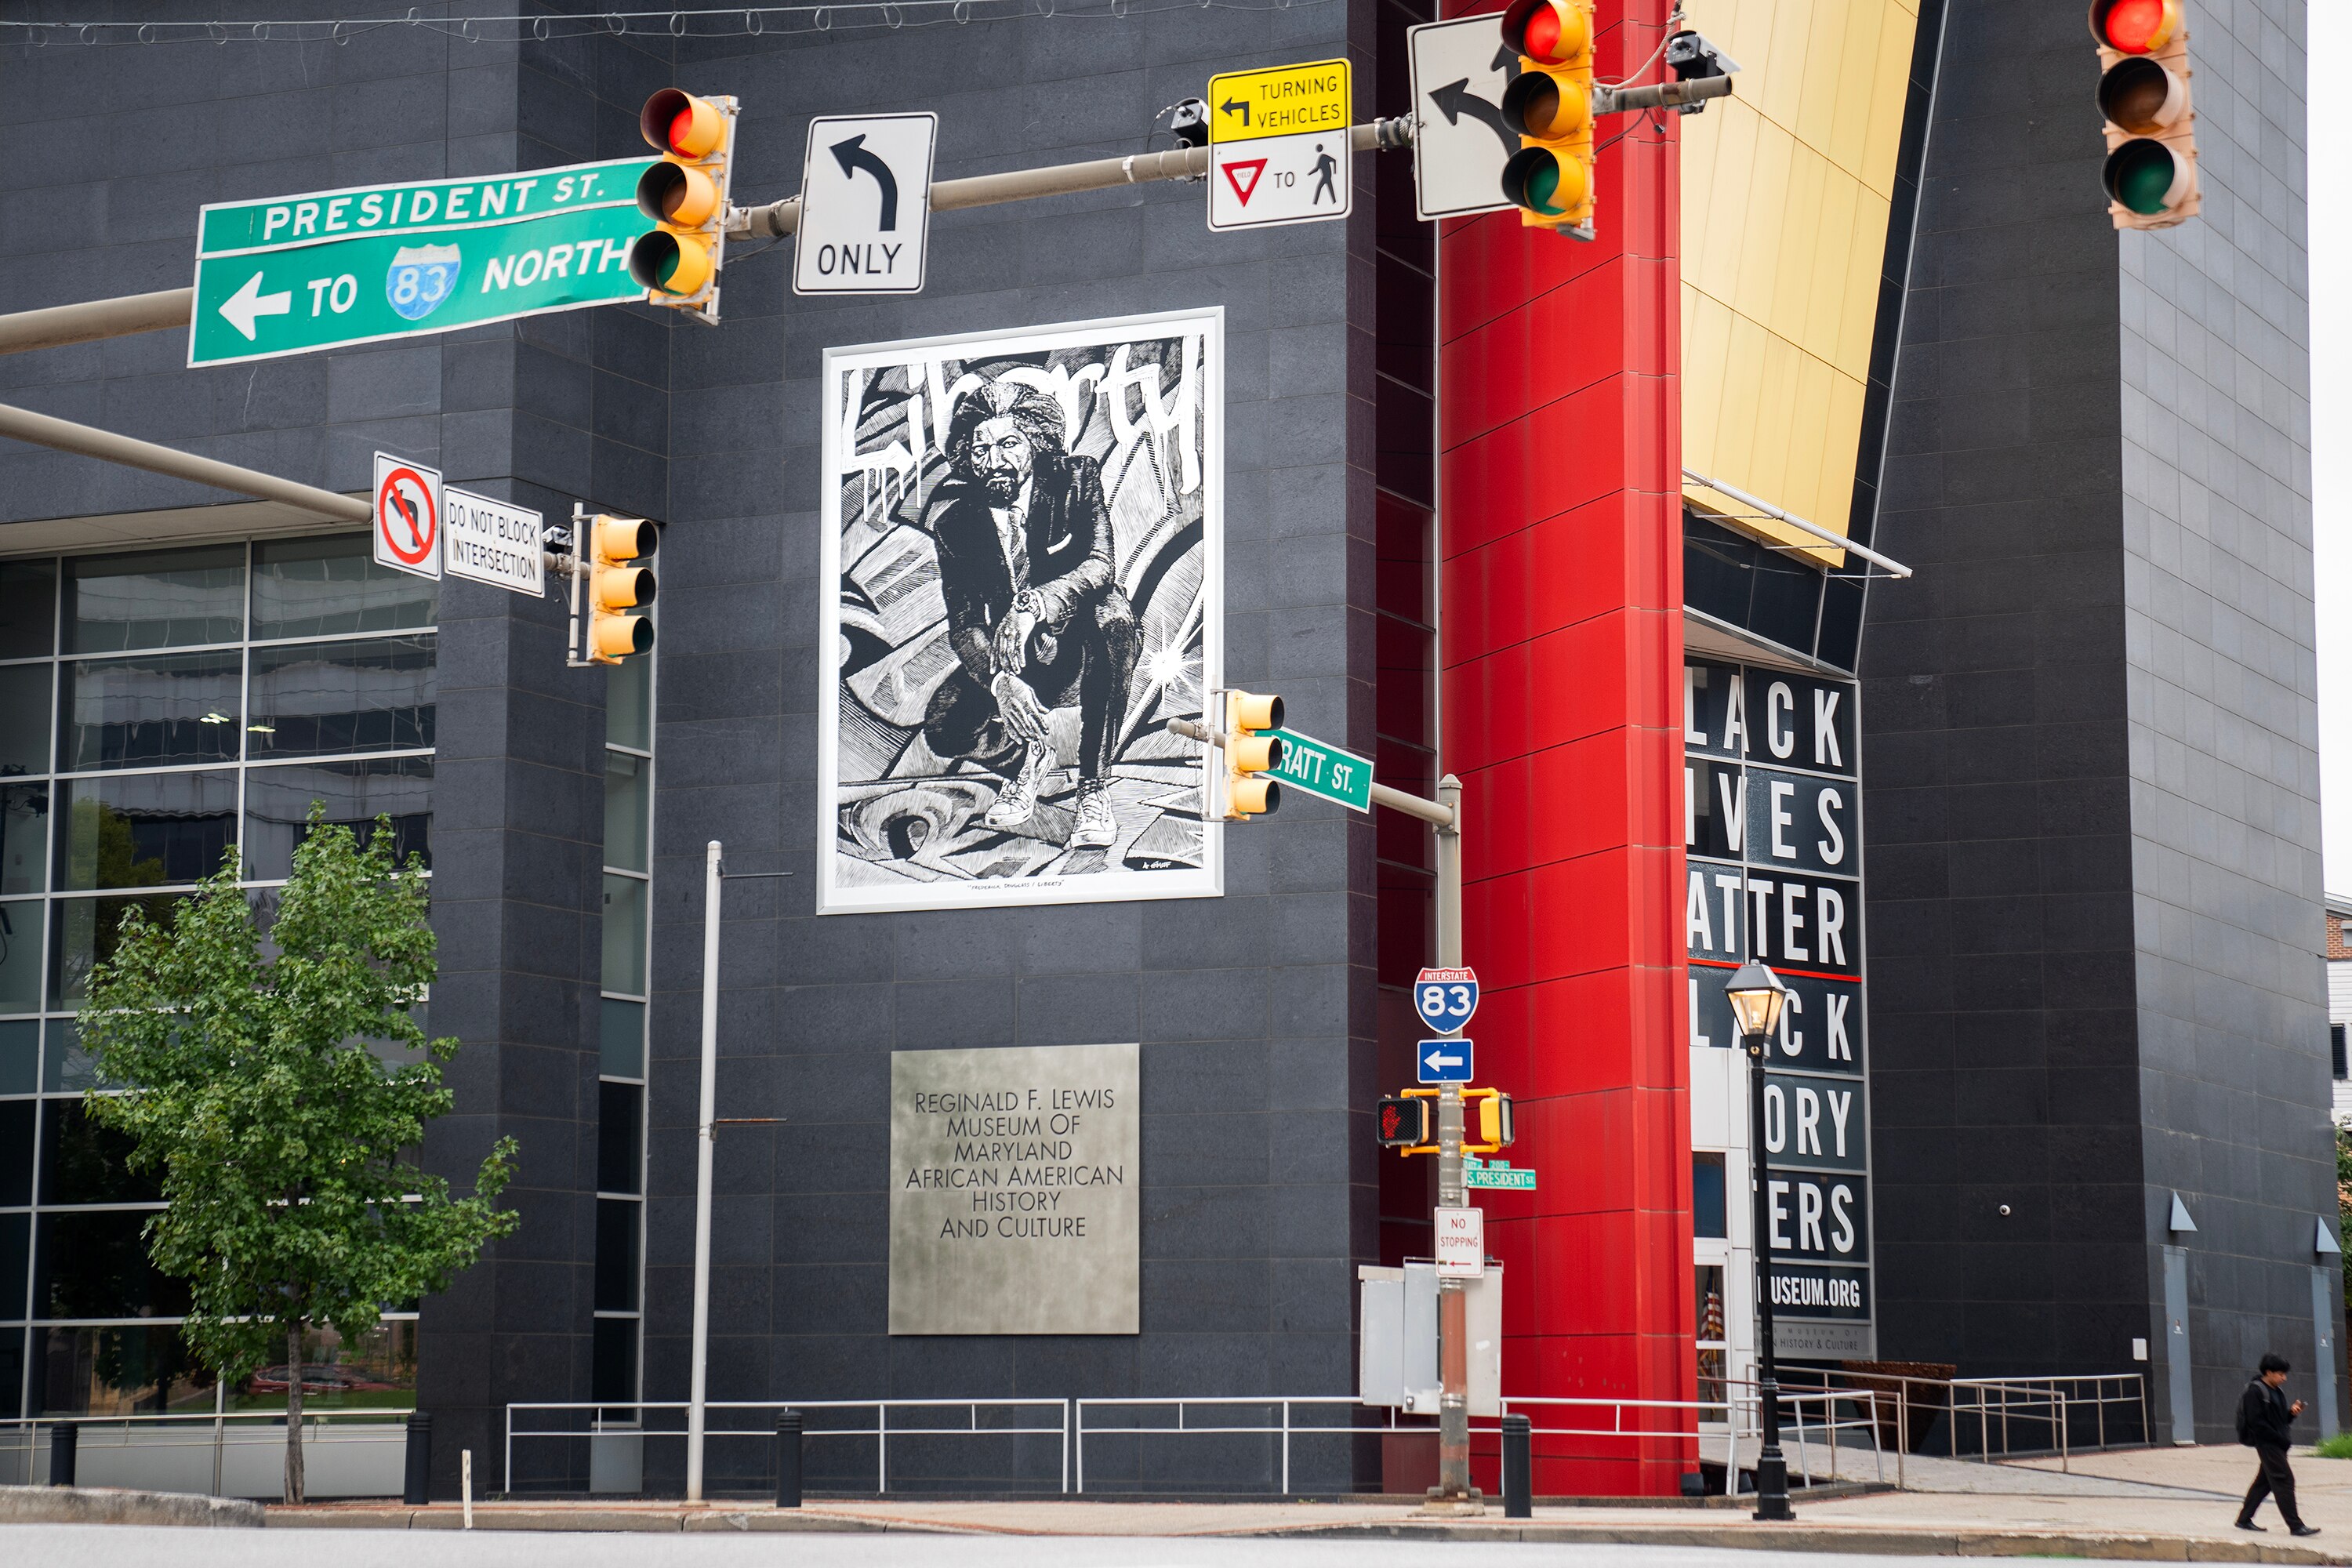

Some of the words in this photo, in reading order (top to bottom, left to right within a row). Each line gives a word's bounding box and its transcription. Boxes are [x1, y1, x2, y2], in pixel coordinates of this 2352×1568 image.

[1259, 75, 1338, 101] TURNING
[1257, 103, 1341, 129] VEHICLES
[1273, 171, 1295, 189] TO
[263, 179, 538, 240] PRESIDENT
[551, 172, 605, 203] ST.
[818, 241, 903, 275] ONLY
[307, 273, 358, 317] TO
[394, 265, 448, 305] 83
[481, 236, 635, 293] NORTH
[449, 502, 466, 528] DO
[470, 508, 494, 535] NOT
[498, 516, 538, 548] BLOCK
[452, 538, 537, 581] INTERSECTION
[1271, 735, 1327, 784] RATT
[1331, 763, 1353, 793] ST.
[1686, 871, 1847, 966] ATTER
[1424, 971, 1468, 981] INTERSTATE
[1421, 985, 1471, 1017] 83
[915, 1092, 1018, 1113] REGINALD
[1027, 1089, 1042, 1110] F.
[1052, 1088, 1115, 1109] LEWIS
[946, 1116, 1041, 1137] MUSEUM
[1050, 1113, 1080, 1135] OF
[954, 1141, 1072, 1162] MARYLAND
[906, 1167, 998, 1189] AFRICAN
[1007, 1165, 1123, 1186] AMERICAN
[1476, 1171, 1526, 1186] PRESIDENT
[972, 1191, 1061, 1212] HISTORY
[940, 1217, 989, 1239] AND
[996, 1216, 1086, 1238] CULTURE
[1451, 1218, 1466, 1229] NO
[1440, 1236, 1479, 1247] STOPPING
[1780, 1338, 1813, 1348] HISTORY
[1825, 1339, 1859, 1351] CULTURE
